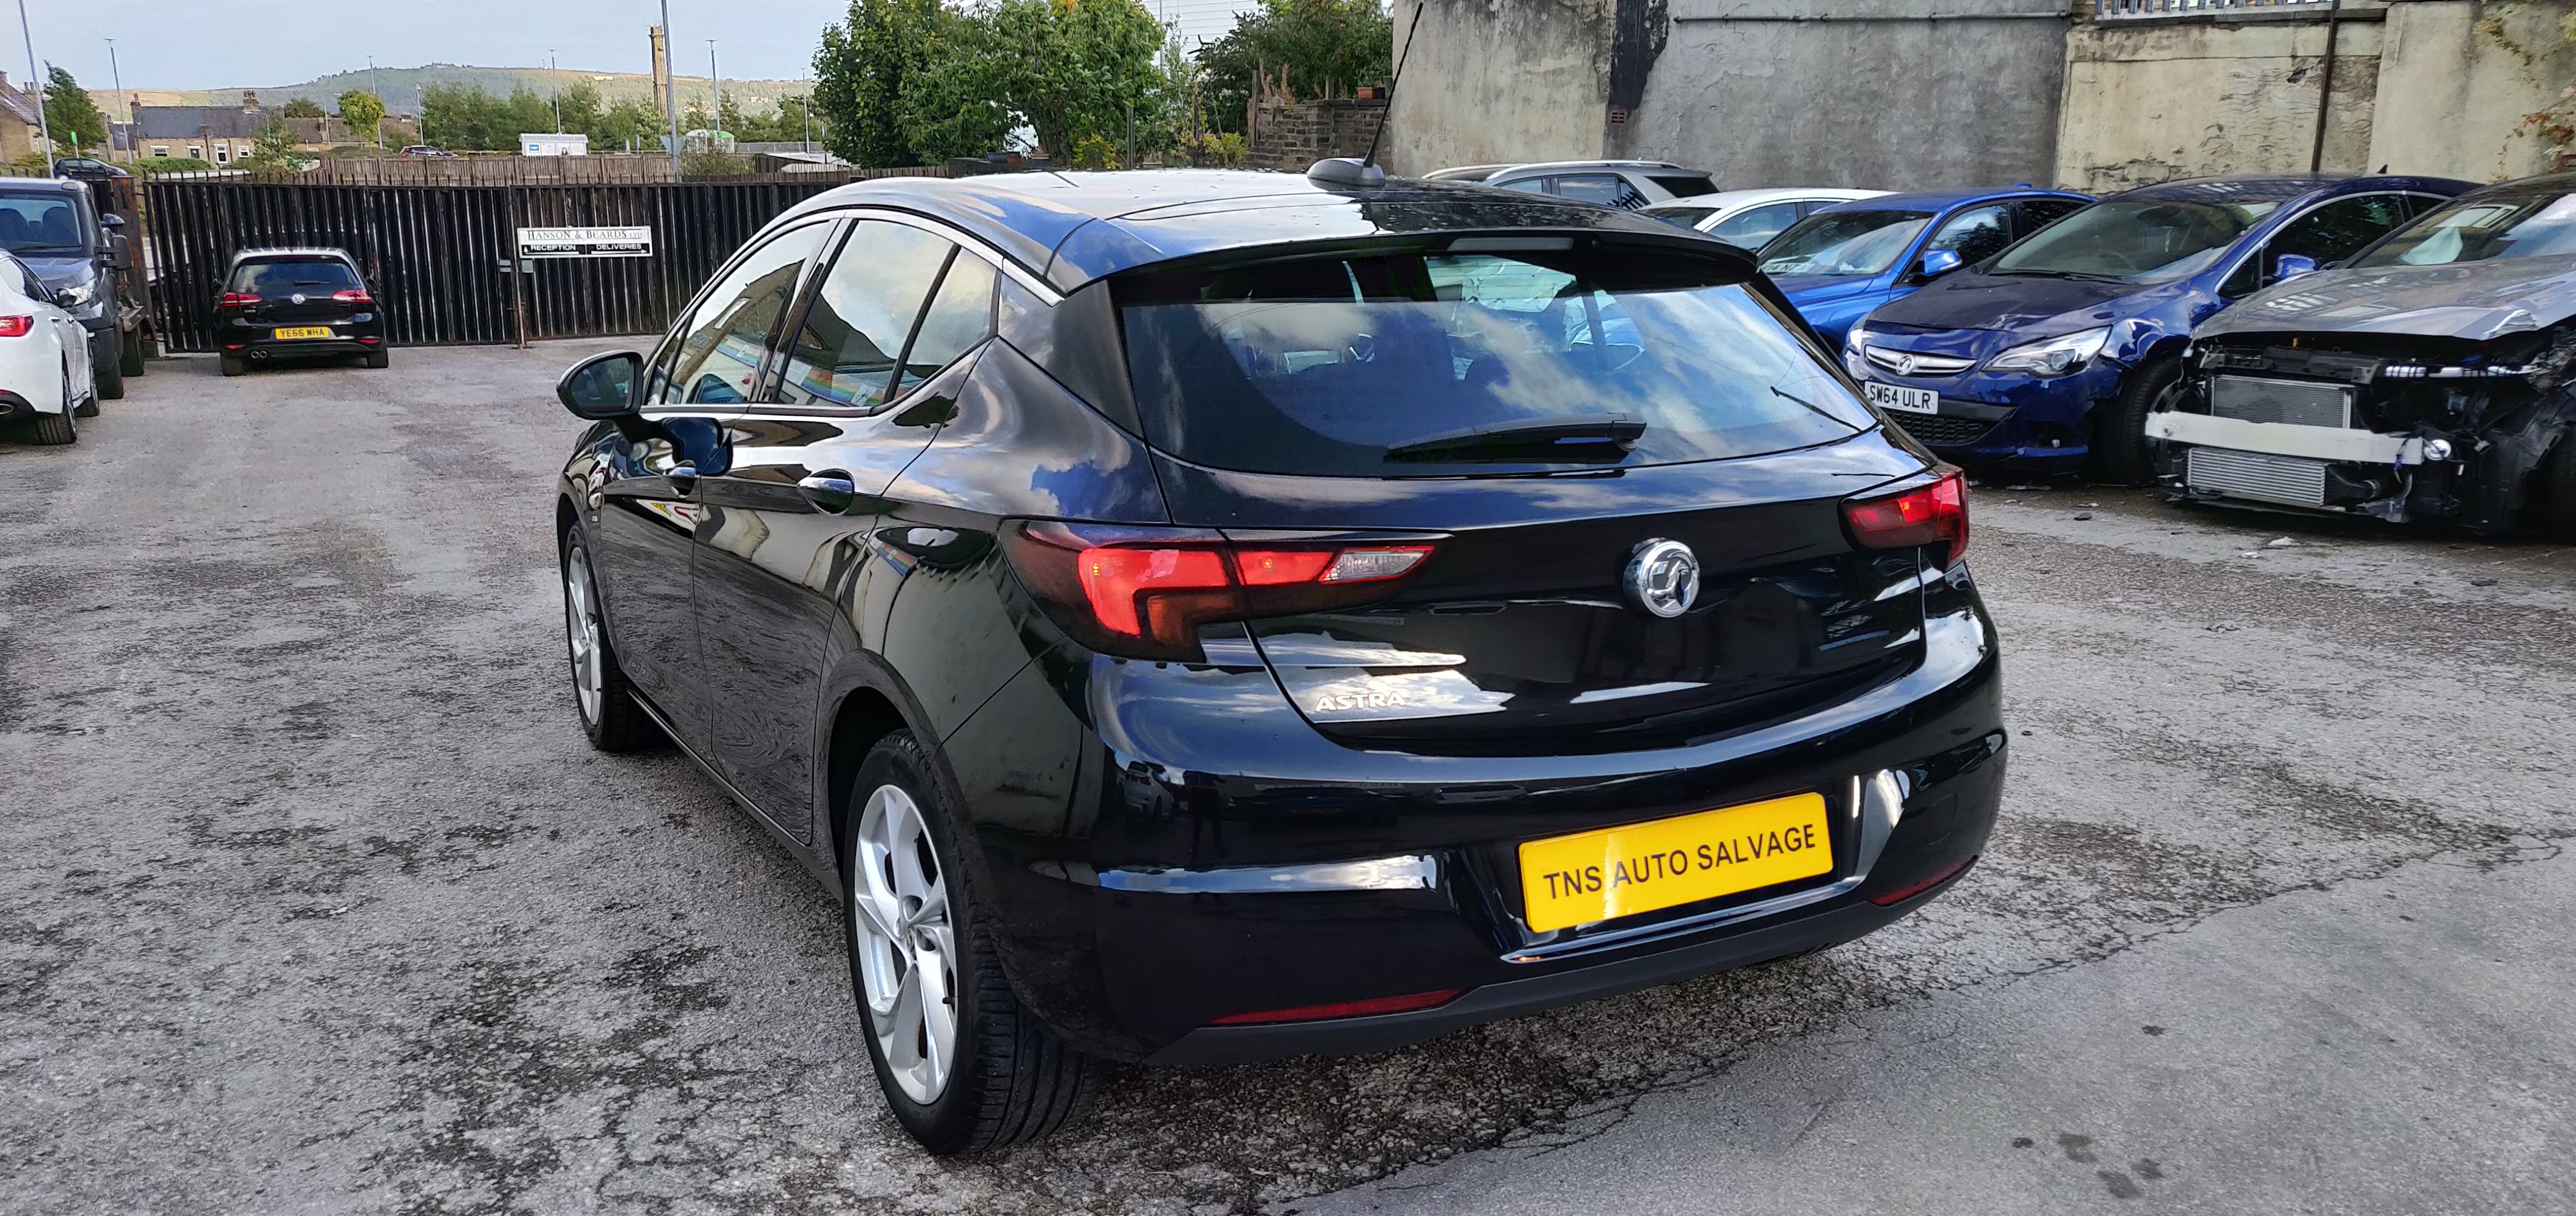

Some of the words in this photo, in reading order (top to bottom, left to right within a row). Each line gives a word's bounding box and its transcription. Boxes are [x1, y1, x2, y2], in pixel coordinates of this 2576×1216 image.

[528, 230, 571, 240] HANSON
[587, 230, 627, 239] BEARDS
[280, 329, 304, 338] YE66
[1870, 385, 1898, 405] SW64
[1902, 390, 1930, 409] ULR
[1315, 691, 1407, 712] ASTRA
[1543, 865, 1602, 899] TNS
[1612, 849, 1688, 889] AUTO
[1697, 823, 1816, 870] SALVAGE
